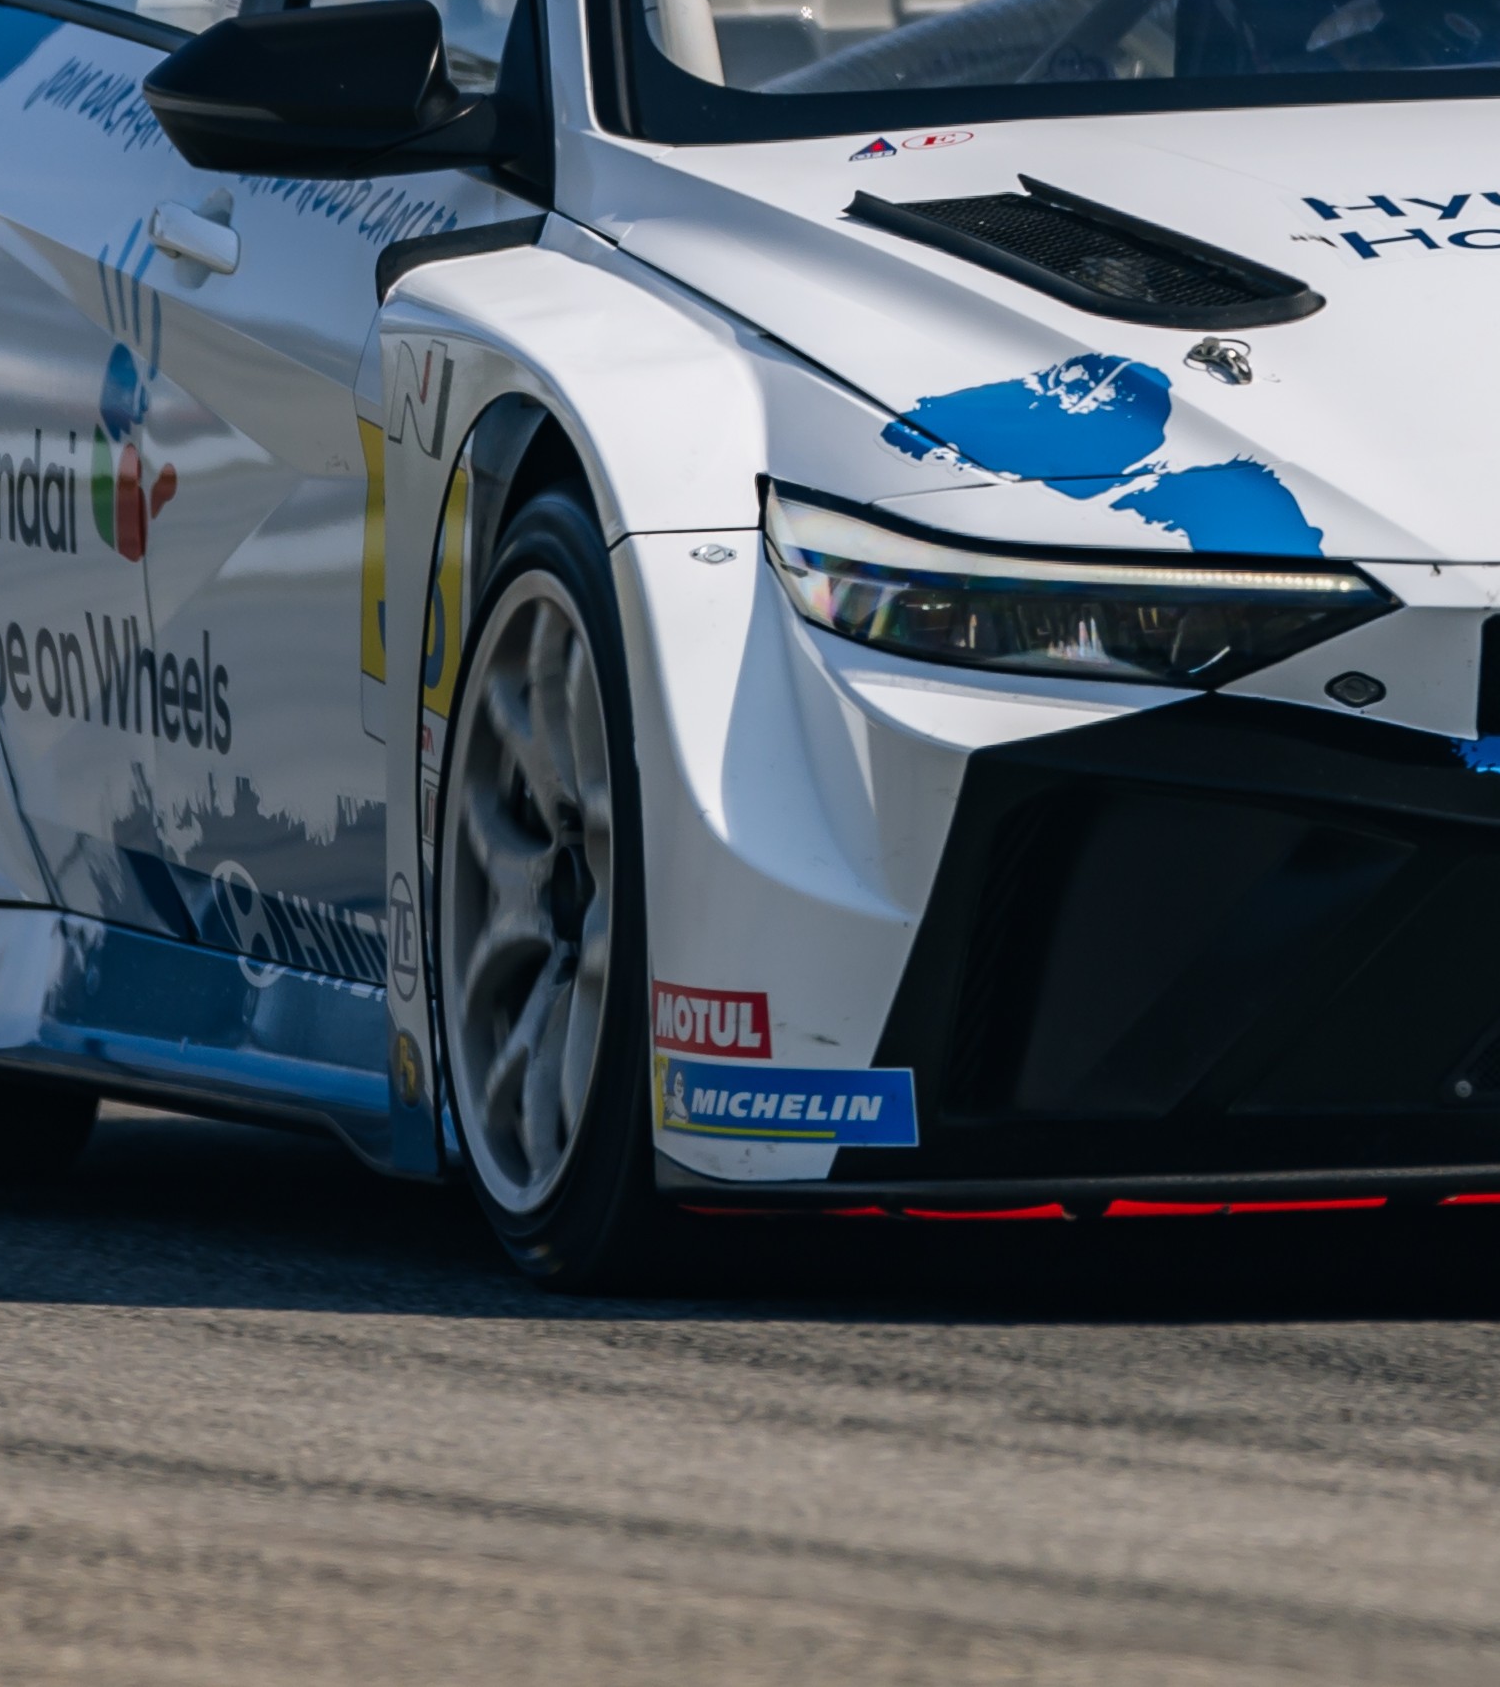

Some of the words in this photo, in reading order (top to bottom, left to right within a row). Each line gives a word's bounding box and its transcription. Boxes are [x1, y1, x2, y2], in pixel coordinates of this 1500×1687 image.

[35, 619, 92, 723] on
[84, 611, 233, 755] Wheels
[655, 991, 763, 1049] MOTUL
[690, 1086, 884, 1122] MICHELIN
